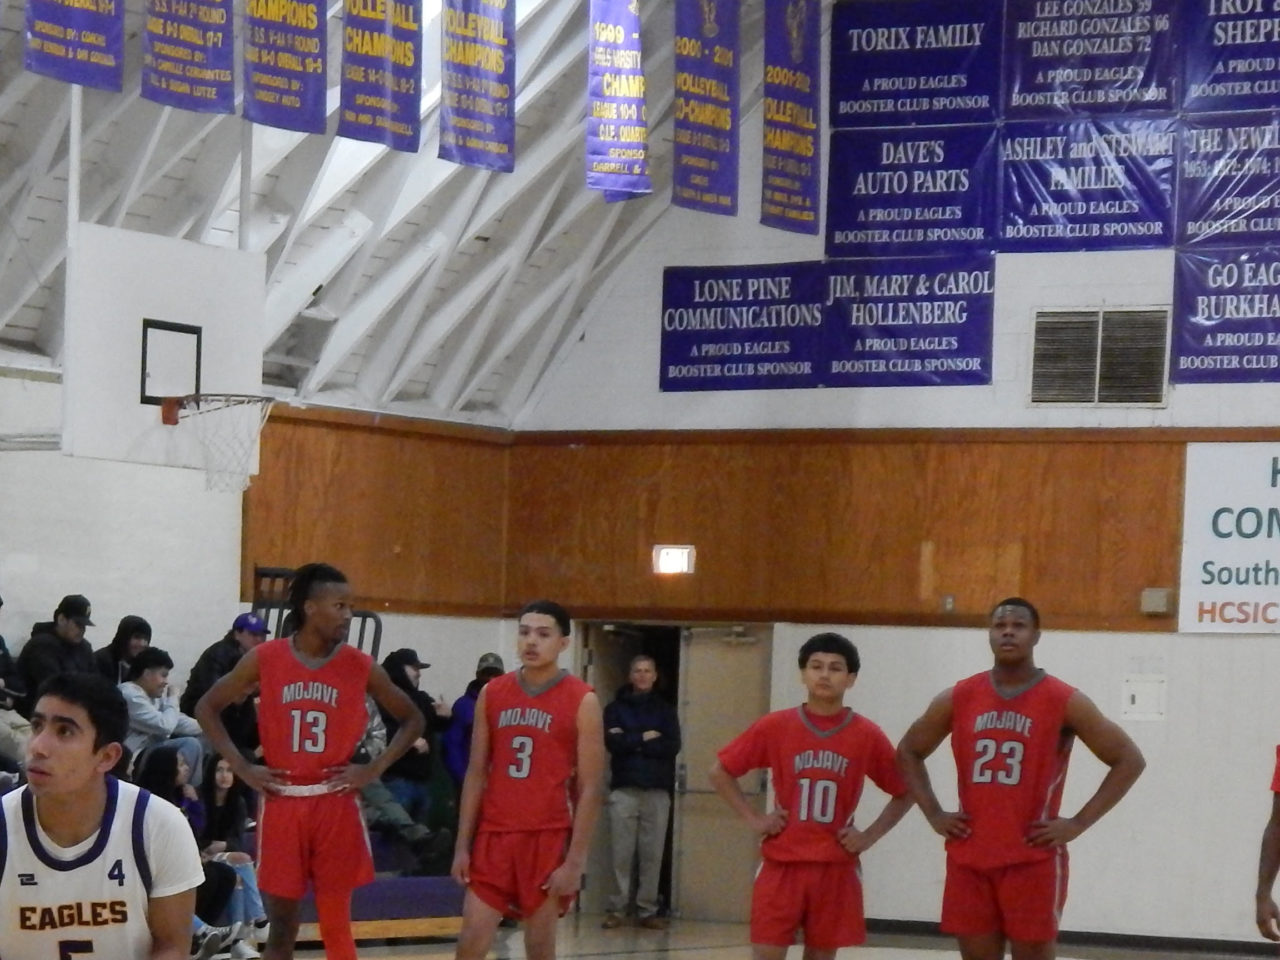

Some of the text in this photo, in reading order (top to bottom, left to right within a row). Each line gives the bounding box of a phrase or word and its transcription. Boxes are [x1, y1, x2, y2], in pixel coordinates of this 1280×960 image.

[1036, 1, 1060, 17] LEE
[1063, 0, 1132, 16] GONZALES
[849, 23, 985, 51] TORIX FAMILY
[1017, 20, 1078, 38] RICHARD
[1081, 16, 1150, 35] GONZALES
[1032, 40, 1060, 57] DAN
[1063, 37, 1133, 56] GONZALES
[1035, 72, 1044, 83] A
[1048, 69, 1092, 83] PROUD
[1215, 58, 1275, 74] A PROUD
[862, 79, 870, 91] A
[873, 77, 916, 90] PROUD
[1191, 81, 1252, 97] BOOSTER
[839, 95, 990, 113] BOOSTER CLUB SPONSOR
[1011, 87, 1167, 106] BOOSTER CLUB SPONSOR
[1003, 132, 1176, 160] ASHLEY and STEWART
[1190, 128, 1222, 152] THE
[853, 169, 969, 195] AUTO PARTS
[1031, 203, 1039, 215] A
[1042, 201, 1086, 215] PROUD
[1225, 196, 1270, 210] PROUD
[857, 209, 865, 222] A
[868, 207, 912, 221] PROUD
[834, 227, 984, 243] BOOSTER CLUB SPONSOR
[1006, 221, 1163, 238] BOOSTER CLUB SPONSOR
[1187, 219, 1247, 234] BOOSTER
[1208, 263, 1238, 288] GO
[694, 277, 791, 302] LONE PINE
[826, 271, 993, 306] JIM, MARY & CAROL
[664, 303, 822, 330] COMMUNICATIONS
[851, 300, 968, 326] HOLLENBERG
[690, 345, 698, 357] A
[701, 343, 741, 356] PROUD
[854, 339, 862, 351] A
[865, 338, 907, 351] PROUD
[1204, 333, 1213, 346] A
[1216, 333, 1264, 346] PROUD
[668, 362, 812, 377] BOOSTER CLUB SPONSOR
[831, 358, 981, 373] BOOSTER CLUB SPONSOR
[1179, 355, 1279, 369] BOOSTER CLUB
[1201, 560, 1280, 586] South
[1197, 601, 1280, 624] HCSIC
[282, 681, 339, 709] MOJAVE
[291, 709, 328, 753] 13
[498, 707, 552, 734] MOJAVE
[973, 710, 1033, 738] MOJAVE
[508, 736, 534, 779] 3
[793, 750, 849, 778] MOJAVE
[972, 739, 1025, 786] 23
[798, 778, 838, 824] 10
[107, 859, 125, 887] 4
[20, 900, 128, 931] EAGLES
